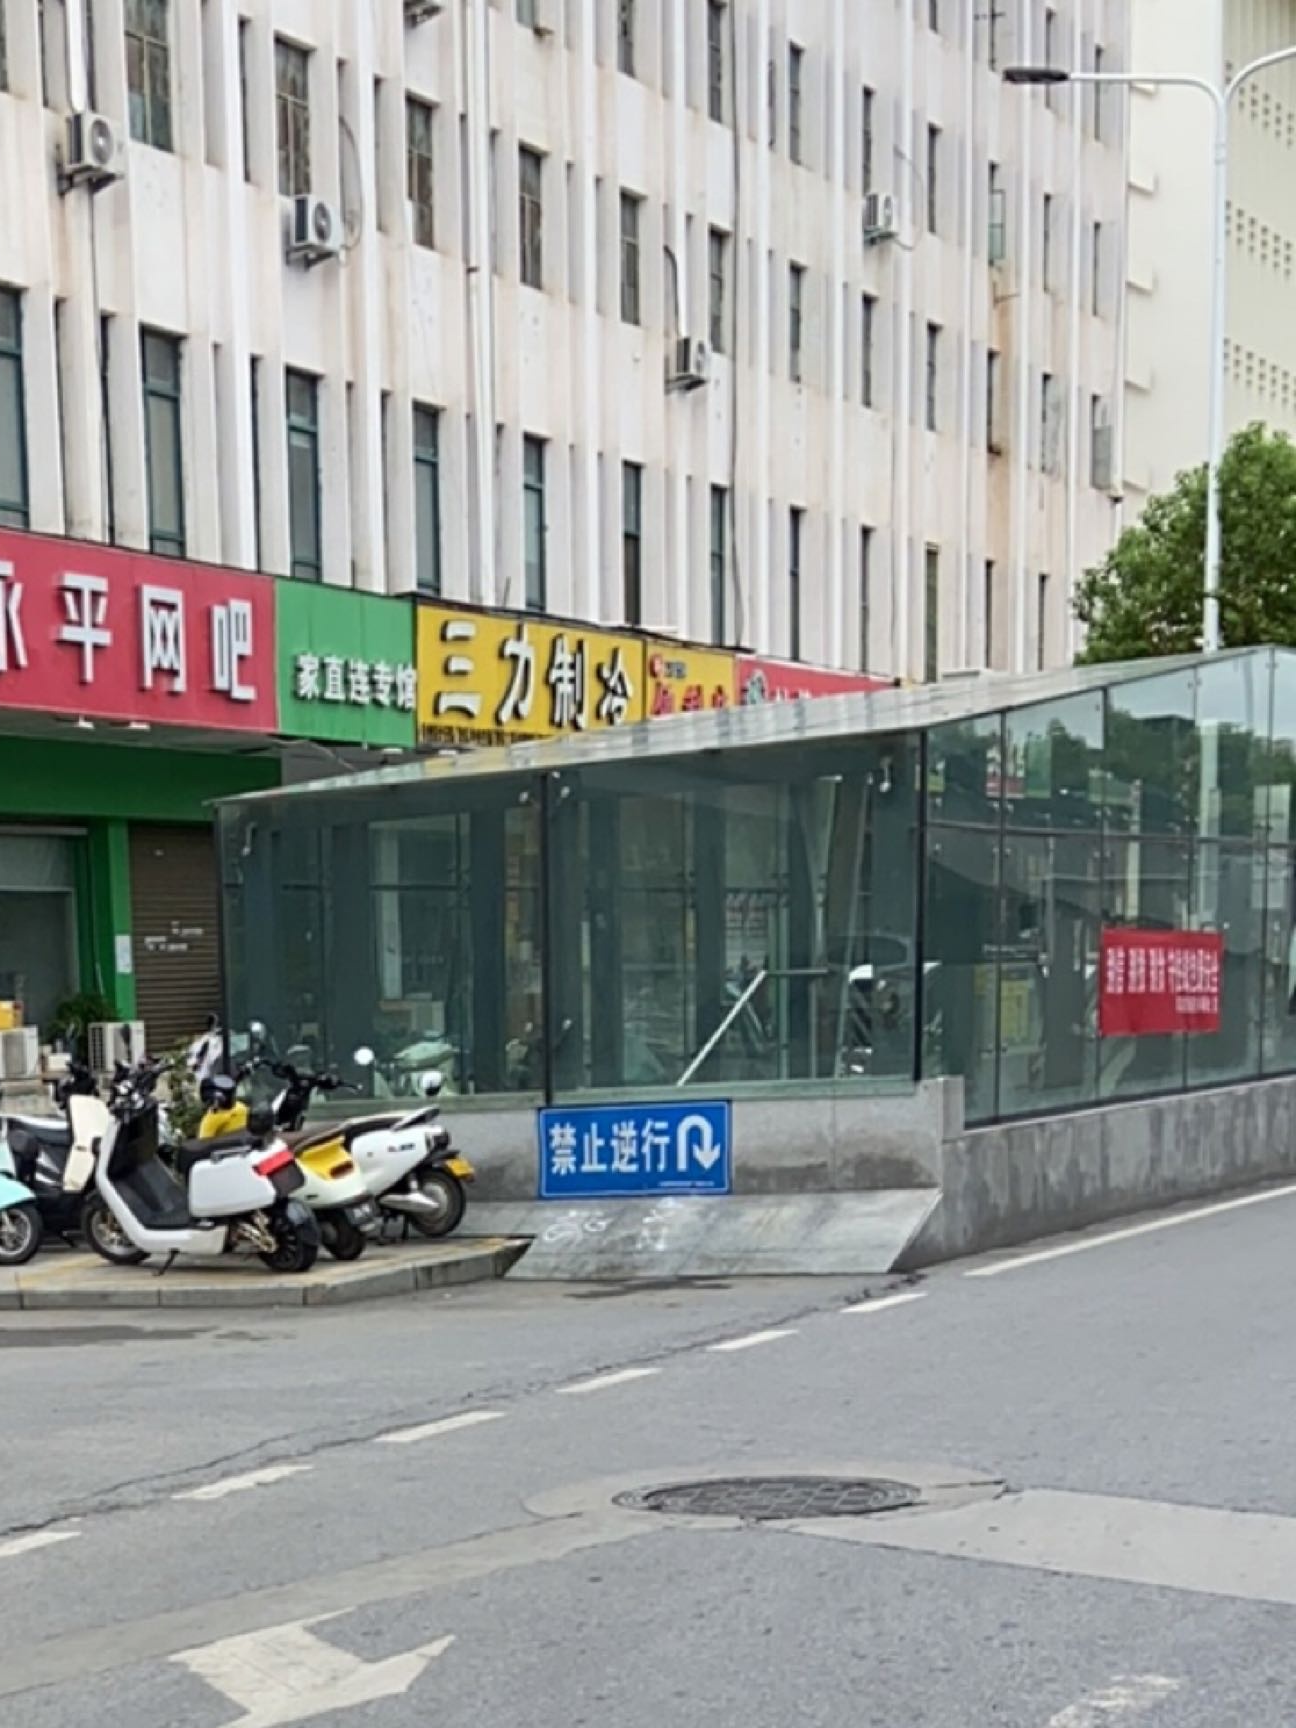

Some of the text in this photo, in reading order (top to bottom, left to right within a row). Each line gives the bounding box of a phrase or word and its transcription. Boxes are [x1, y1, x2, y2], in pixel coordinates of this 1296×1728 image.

[433, 619, 635, 731] 三力制冷
[548, 1118, 671, 1177] 禁止逆行
